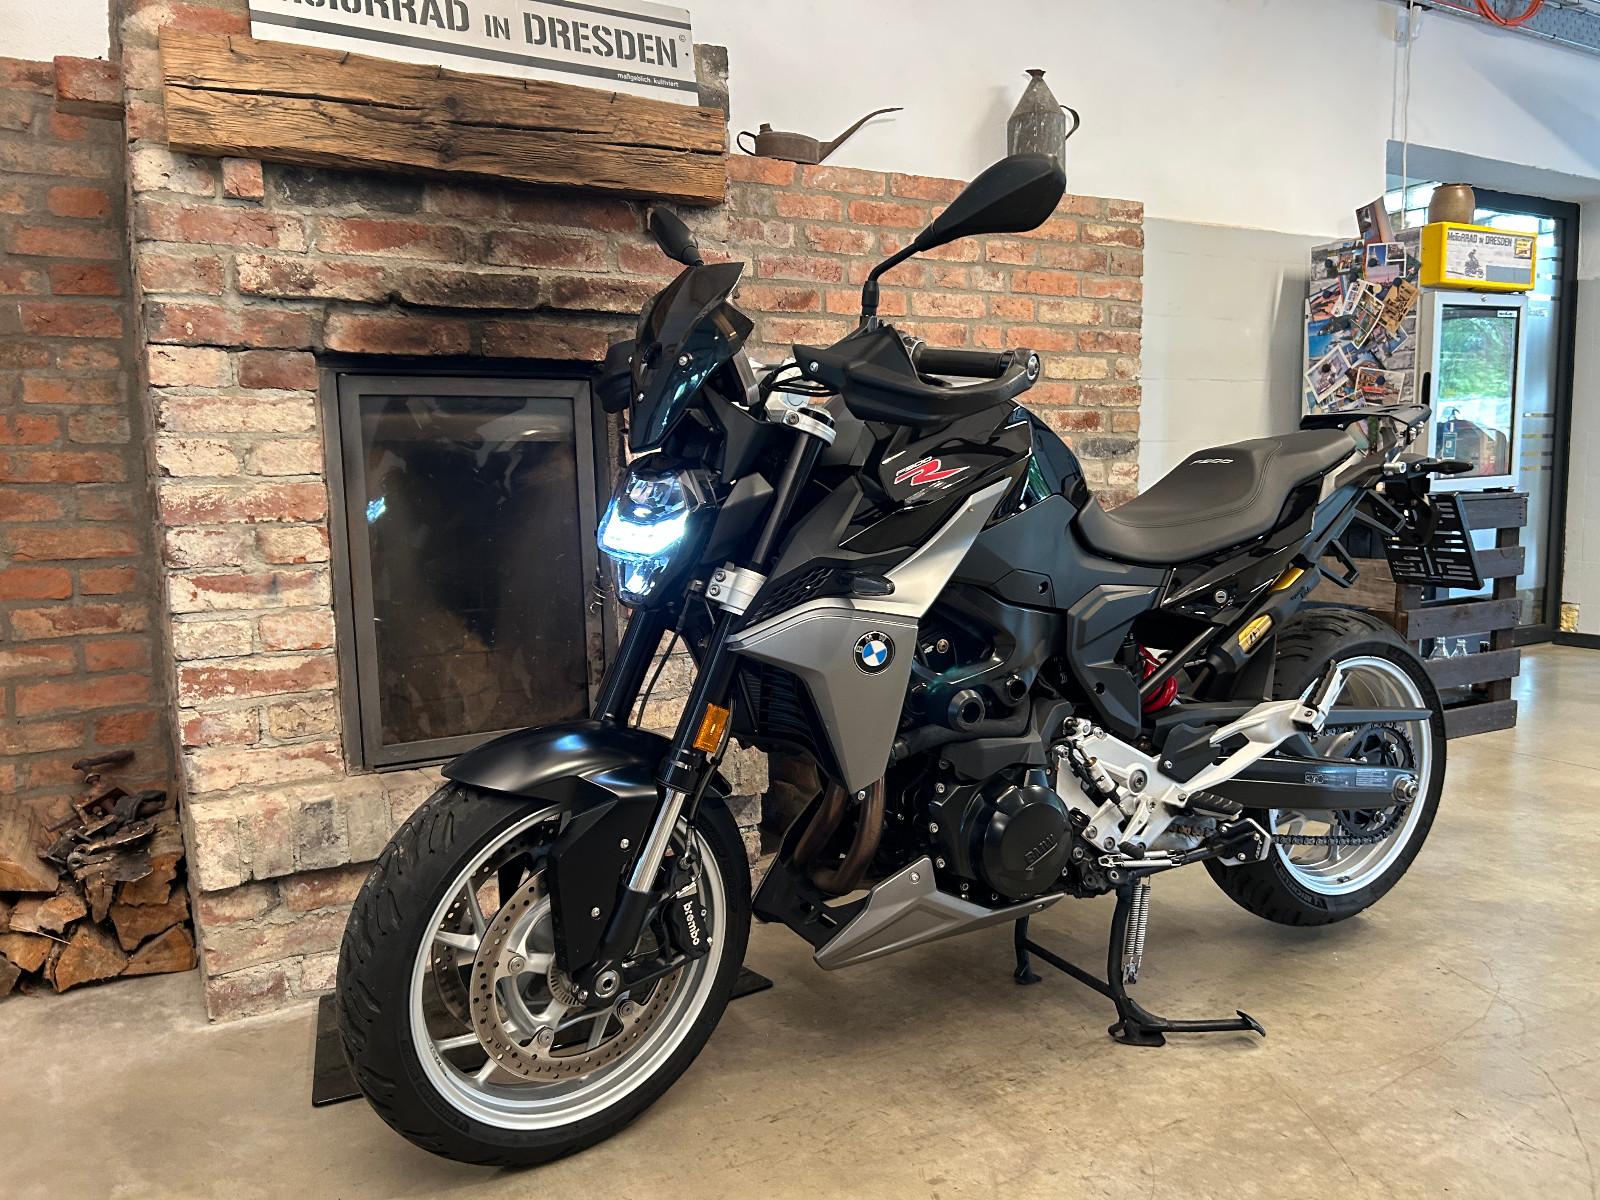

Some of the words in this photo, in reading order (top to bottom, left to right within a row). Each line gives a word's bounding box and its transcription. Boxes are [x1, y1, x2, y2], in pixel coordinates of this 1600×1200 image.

[484, 14, 511, 40] IN
[523, 12, 678, 68] DRESDEN
[1485, 235, 1513, 247] DRESDEN
[683, 900, 700, 946] brembo
